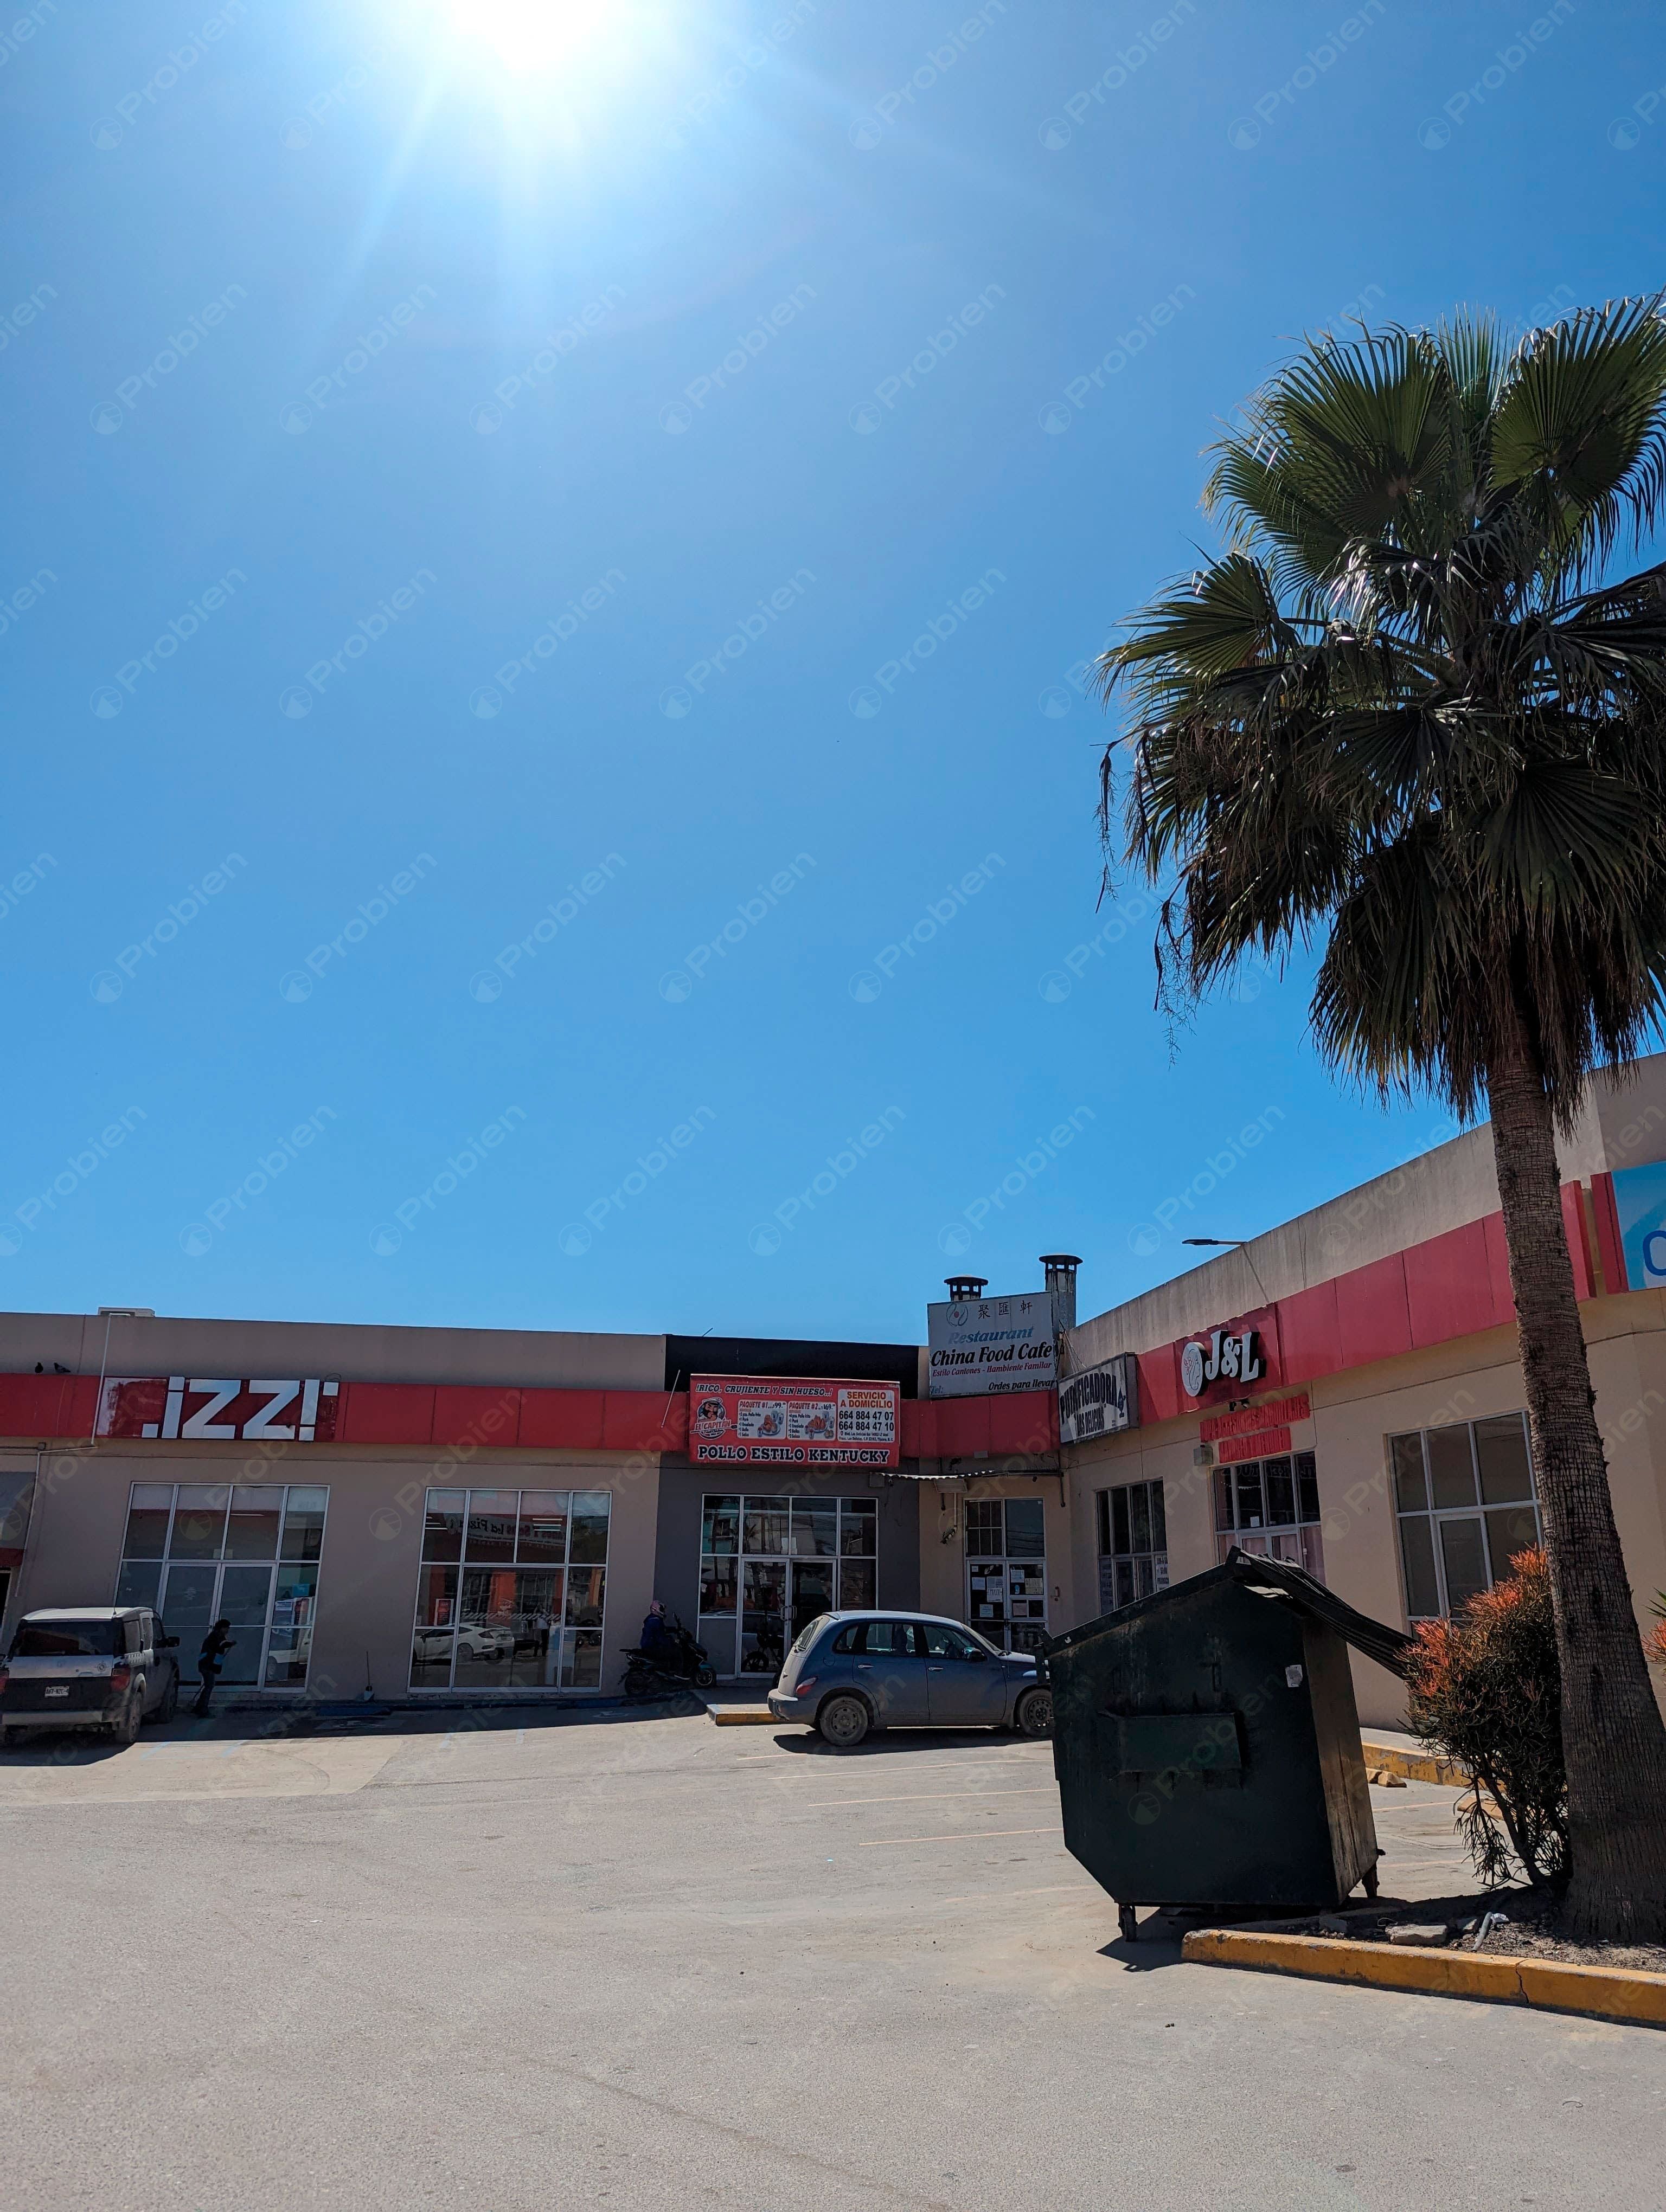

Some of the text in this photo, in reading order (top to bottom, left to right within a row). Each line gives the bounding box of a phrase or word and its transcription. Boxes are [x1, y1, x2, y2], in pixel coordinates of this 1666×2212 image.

[950, 1326, 1034, 1344] Restaurant
[931, 1342, 1053, 1366] China Food Cafe
[1204, 1329, 1260, 1383] J&L
[725, 1385, 770, 1394] CRUJIENTE
[989, 1382, 1010, 1390] Ordes
[1012, 1381, 1030, 1390] para
[849, 1400, 892, 1408] DOMICILIO
[839, 1411, 894, 1420] 664 884 47 07
[839, 1421, 894, 1431] 664 884 47 10
[699, 1446, 889, 1462] POLLO ESTILO KENTUCKY
